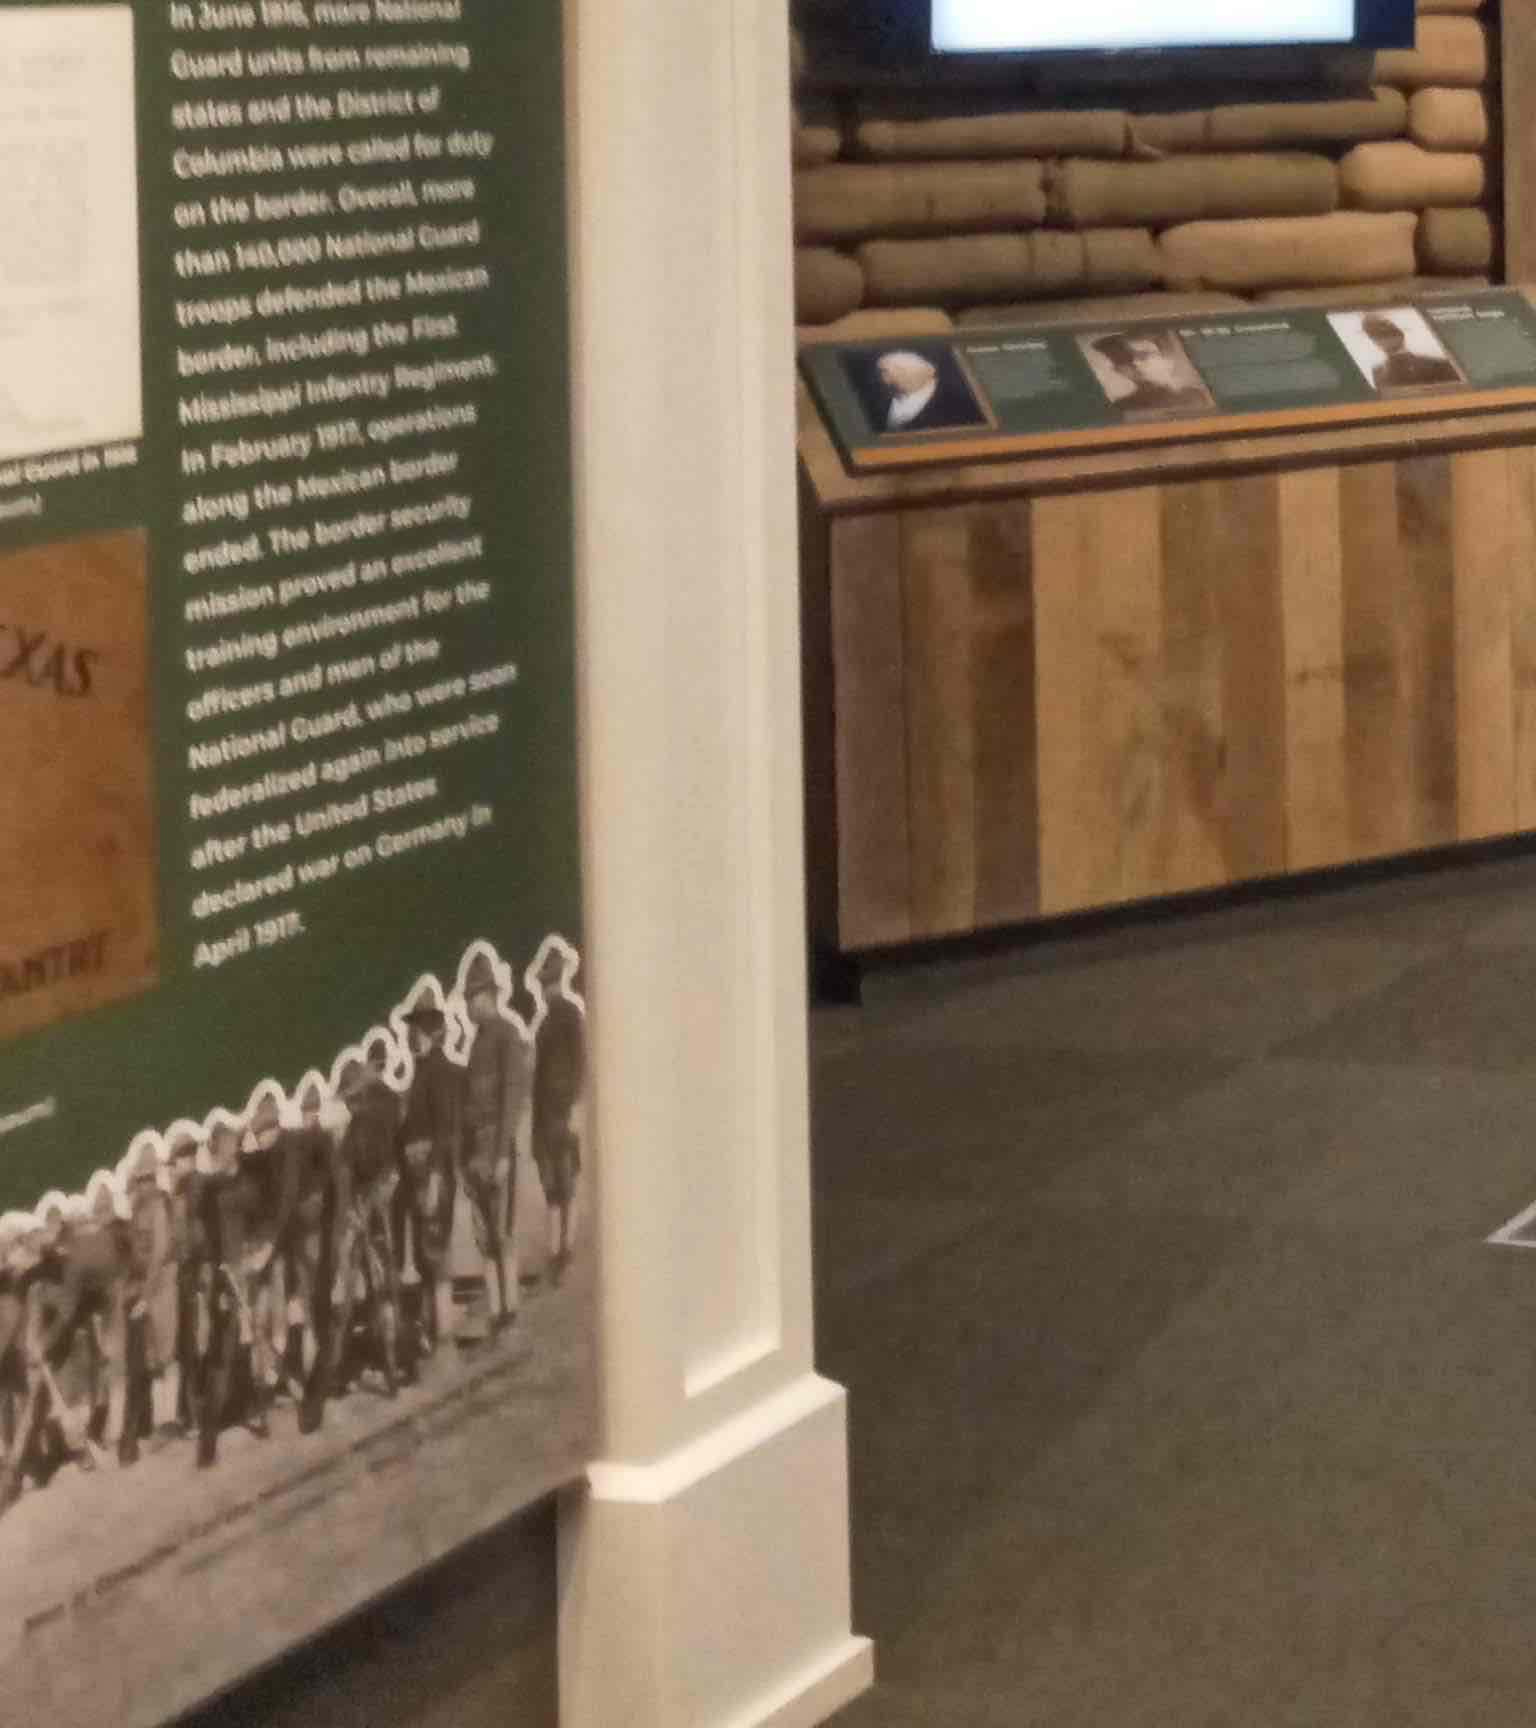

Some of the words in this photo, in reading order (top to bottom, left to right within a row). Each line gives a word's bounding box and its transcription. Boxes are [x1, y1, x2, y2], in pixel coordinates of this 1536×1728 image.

[171, 1, 194, 31] In
[314, 0, 371, 25] more
[171, 47, 243, 80] Guard
[248, 45, 304, 76] units
[308, 43, 360, 72] from
[365, 43, 470, 71] remaining
[172, 98, 243, 130] states
[247, 95, 292, 125] and
[295, 93, 333, 122] the
[337, 89, 414, 119] District
[417, 85, 441, 112] of
[174, 145, 284, 179] Columbia
[288, 142, 343, 169] were
[347, 134, 410, 164] called
[413, 132, 443, 158] for
[446, 130, 494, 159] duty
[174, 201, 206, 229] on
[209, 195, 249, 225] the
[421, 178, 475, 204] more
[175, 249, 231, 279] than
[326, 227, 415, 261] National
[418, 217, 480, 250] Guard
[176, 296, 253, 328] troops
[256, 278, 361, 317] defended
[366, 275, 401, 303] the
[405, 265, 490, 296] Mexican
[265, 328, 369, 362] including
[372, 321, 409, 348] the
[412, 314, 459, 341] First
[306, 372, 390, 405] Infantry
[182, 447, 206, 475] In
[211, 432, 313, 468] February
[367, 403, 479, 444] operations
[183, 491, 249, 526] along
[254, 482, 293, 512] the
[297, 467, 386, 502] Mexican
[390, 451, 459, 484] border
[268, 526, 310, 556] The
[314, 512, 386, 547] border
[390, 493, 472, 529] security
[185, 584, 275, 623] mission
[279, 562, 357, 607] proved
[360, 559, 389, 583] an
[392, 535, 483, 577] excellent
[185, 632, 279, 673] training
[282, 595, 420, 649] environment
[423, 588, 452, 614] for
[455, 580, 491, 606] the
[187, 682, 275, 721] officers
[279, 663, 323, 698] and
[326, 656, 375, 685] men
[379, 642, 403, 672] of
[404, 636, 441, 665] the
[188, 721, 287, 771] National
[366, 692, 413, 721] who
[414, 678, 467, 707] were
[468, 662, 518, 693] soon
[190, 760, 318, 821] federalized
[321, 748, 382, 784] again
[385, 734, 427, 763] into
[429, 713, 500, 749] service
[191, 835, 249, 871] after
[251, 823, 292, 850] the
[295, 794, 370, 838] United
[372, 776, 438, 813] States
[192, 864, 296, 919] declared
[298, 855, 341, 885] war
[343, 844, 374, 870] on
[375, 813, 470, 859] Germany
[471, 802, 494, 827] in
[193, 926, 251, 970] April
